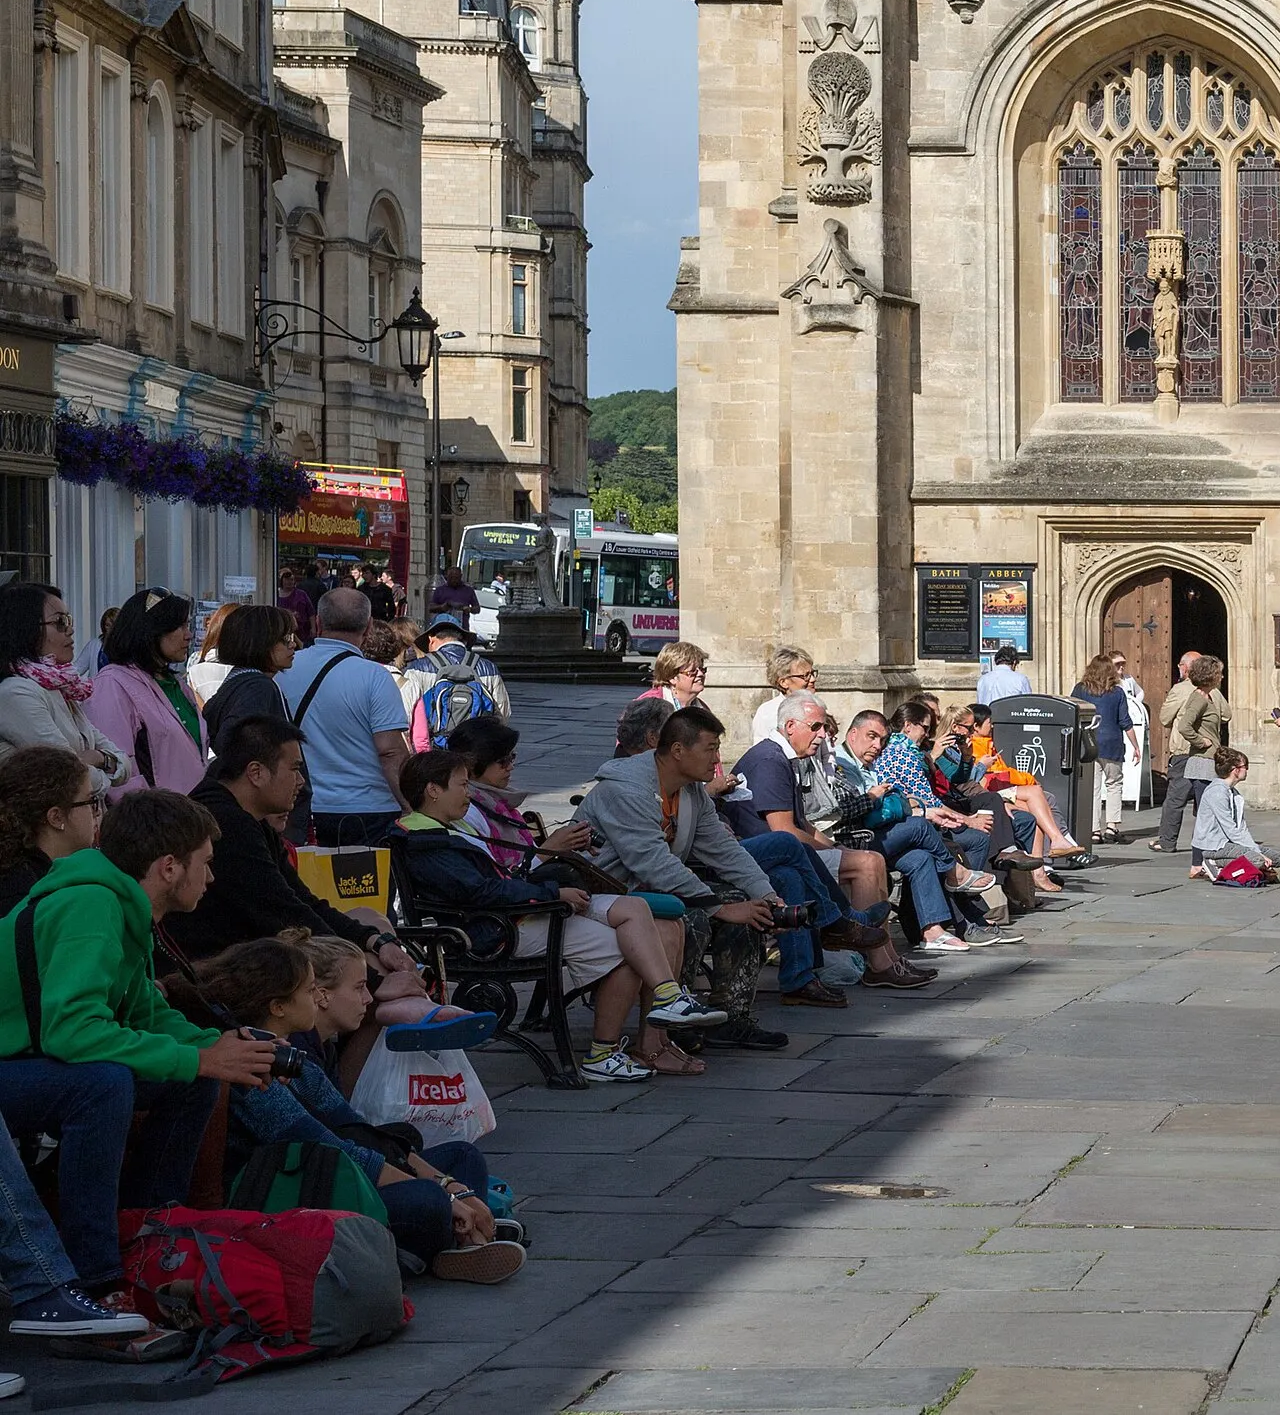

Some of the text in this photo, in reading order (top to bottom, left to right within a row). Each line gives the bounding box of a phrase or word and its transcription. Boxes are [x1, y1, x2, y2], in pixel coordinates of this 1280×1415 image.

[483, 530, 520, 540] University
[498, 536, 514, 545] Bath
[605, 543, 613, 552] 18
[931, 569, 1024, 578] BATH ABBEY
[338, 876, 357, 887] Jack
[338, 884, 375, 896] Wolfskin
